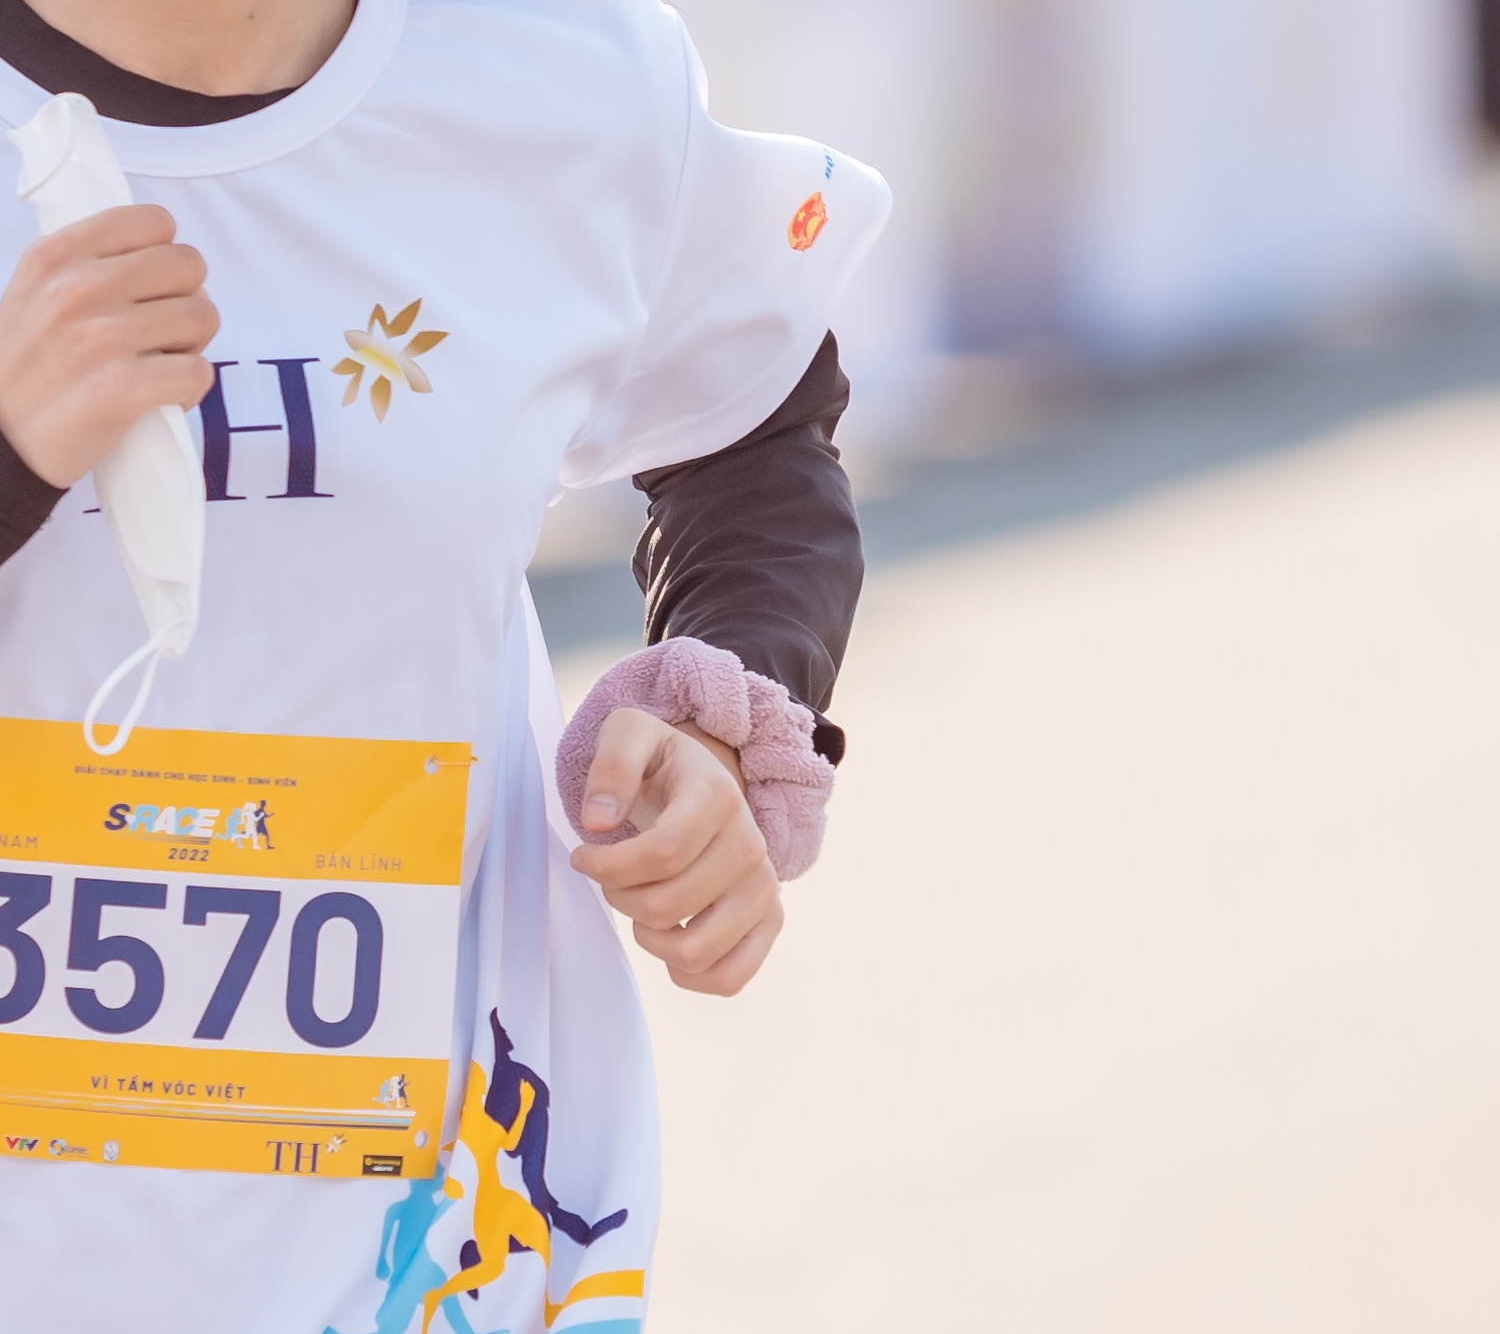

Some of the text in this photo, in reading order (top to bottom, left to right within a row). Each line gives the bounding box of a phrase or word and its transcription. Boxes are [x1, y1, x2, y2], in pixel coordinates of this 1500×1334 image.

[167, 847, 210, 862] 2022
[315, 851, 402, 871] BẢN LĨNH
[91, 1075, 109, 1090] VÌ
[162, 1080, 197, 1096] VÓC
[206, 1083, 247, 1102] VIỆT
[4, 1136, 39, 1152] VTV
[266, 1141, 322, 1173] TH
